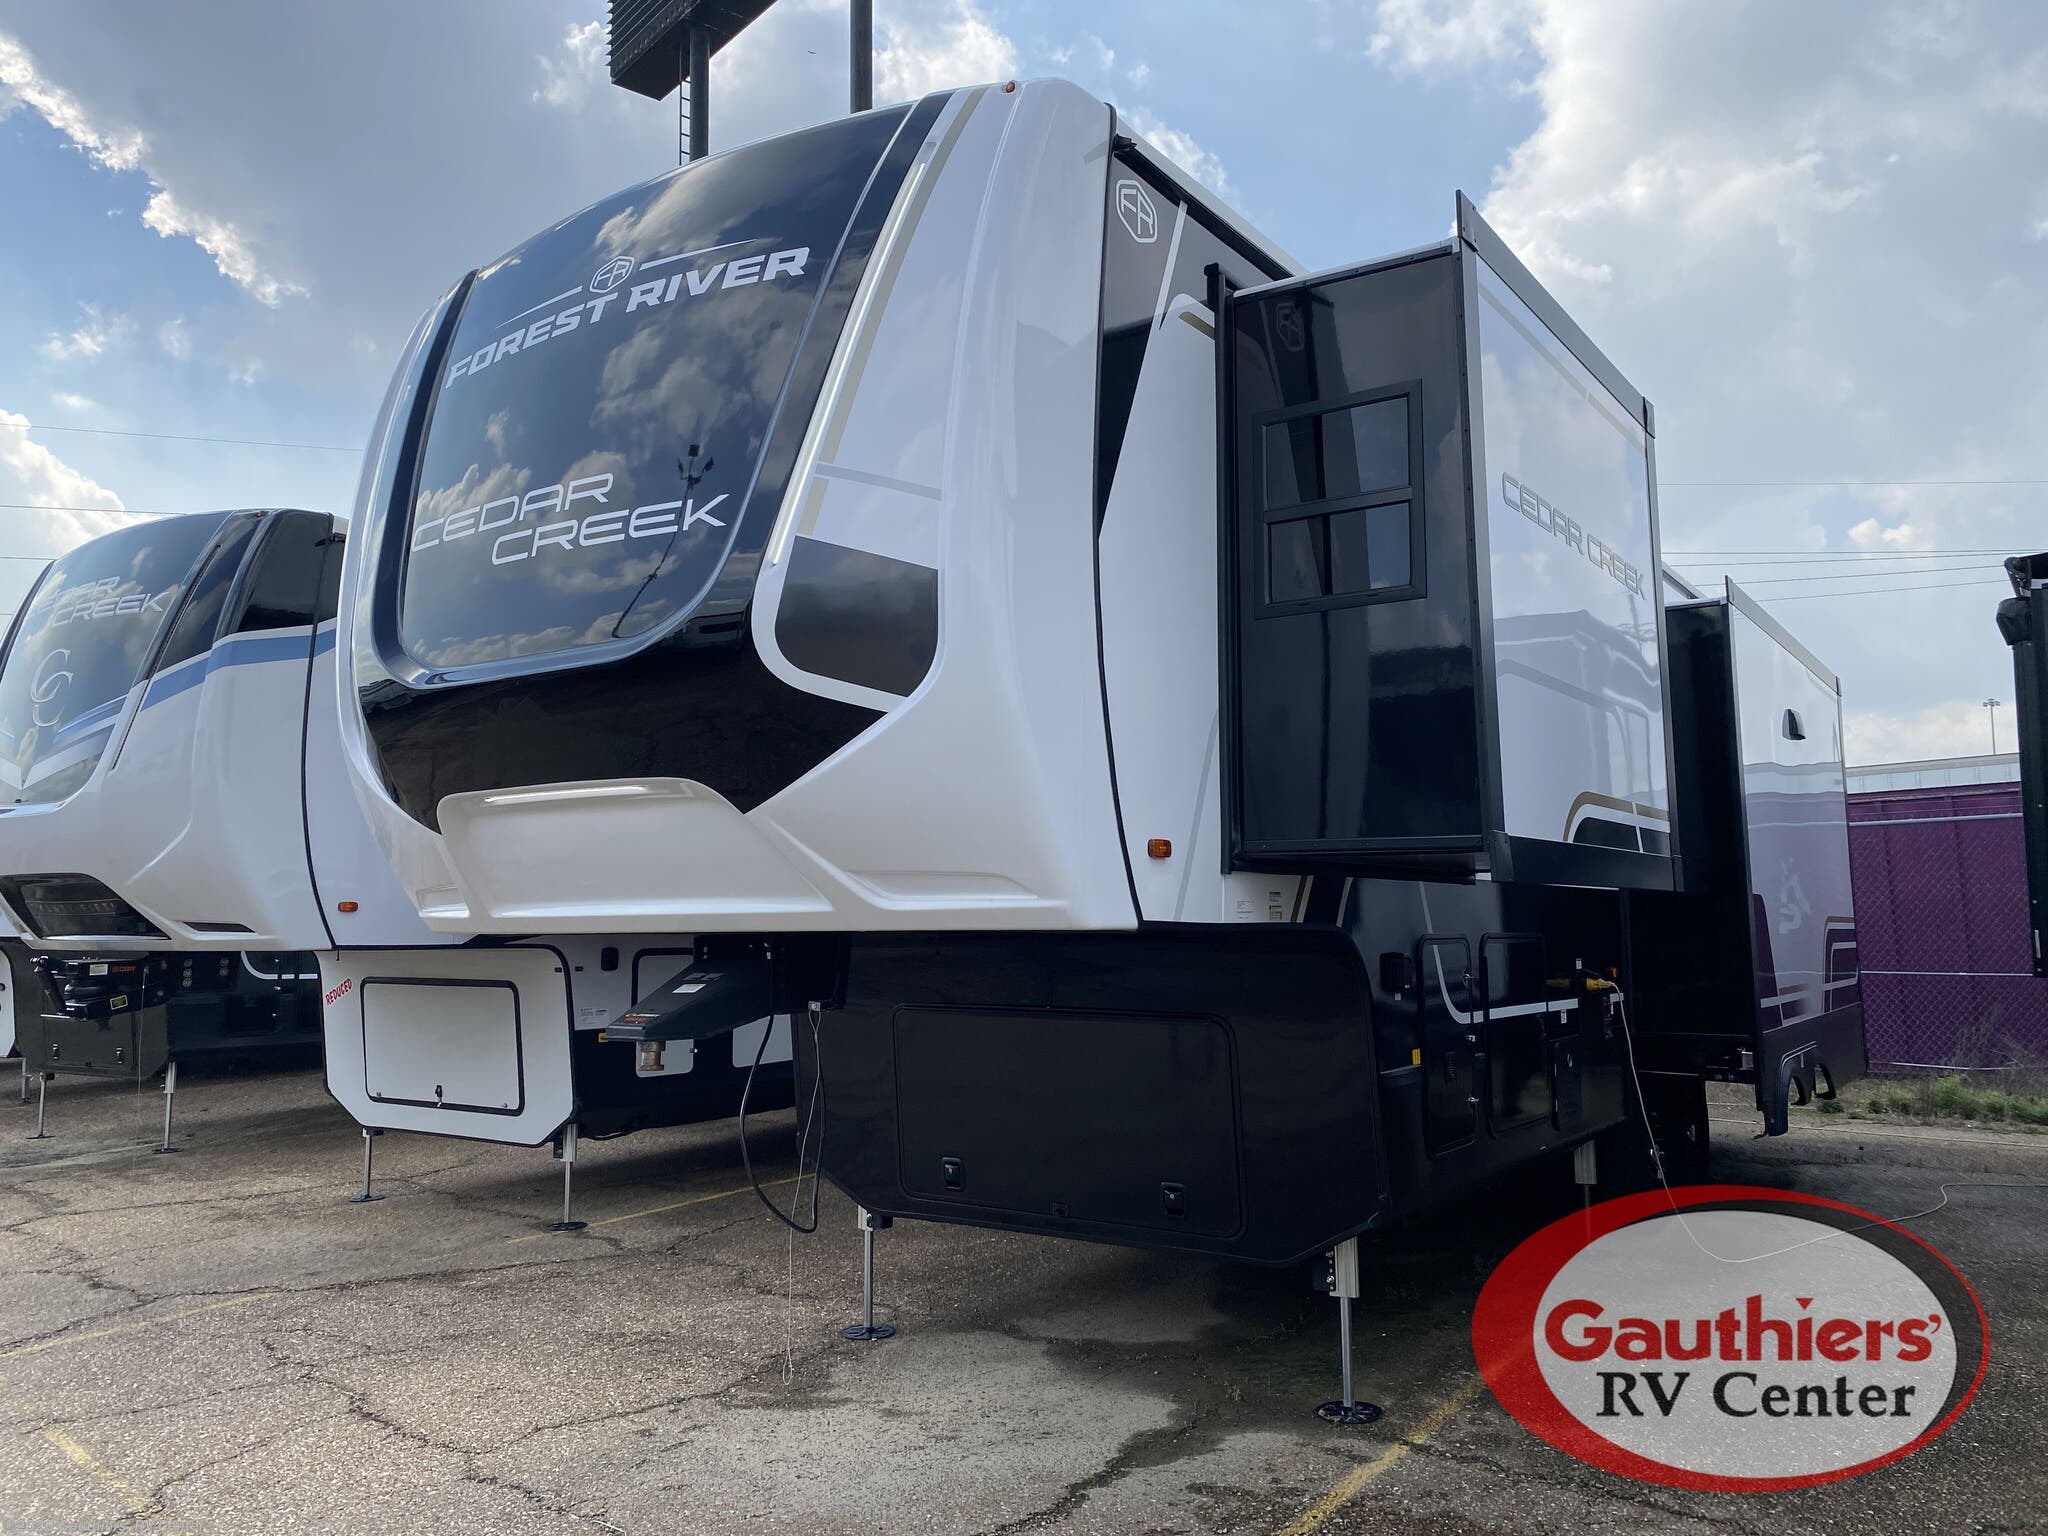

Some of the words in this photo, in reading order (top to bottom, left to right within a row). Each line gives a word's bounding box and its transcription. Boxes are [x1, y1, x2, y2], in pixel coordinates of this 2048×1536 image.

[445, 293, 618, 389] FOREST
[625, 246, 810, 313] RIVER
[411, 472, 614, 553] CEDAR
[491, 493, 731, 566] CREEK
[1502, 471, 1584, 556] CEDAR
[1587, 533, 1647, 601] CREEK
[52, 591, 169, 627] CREEK
[325, 977, 353, 1006] REDUCED
